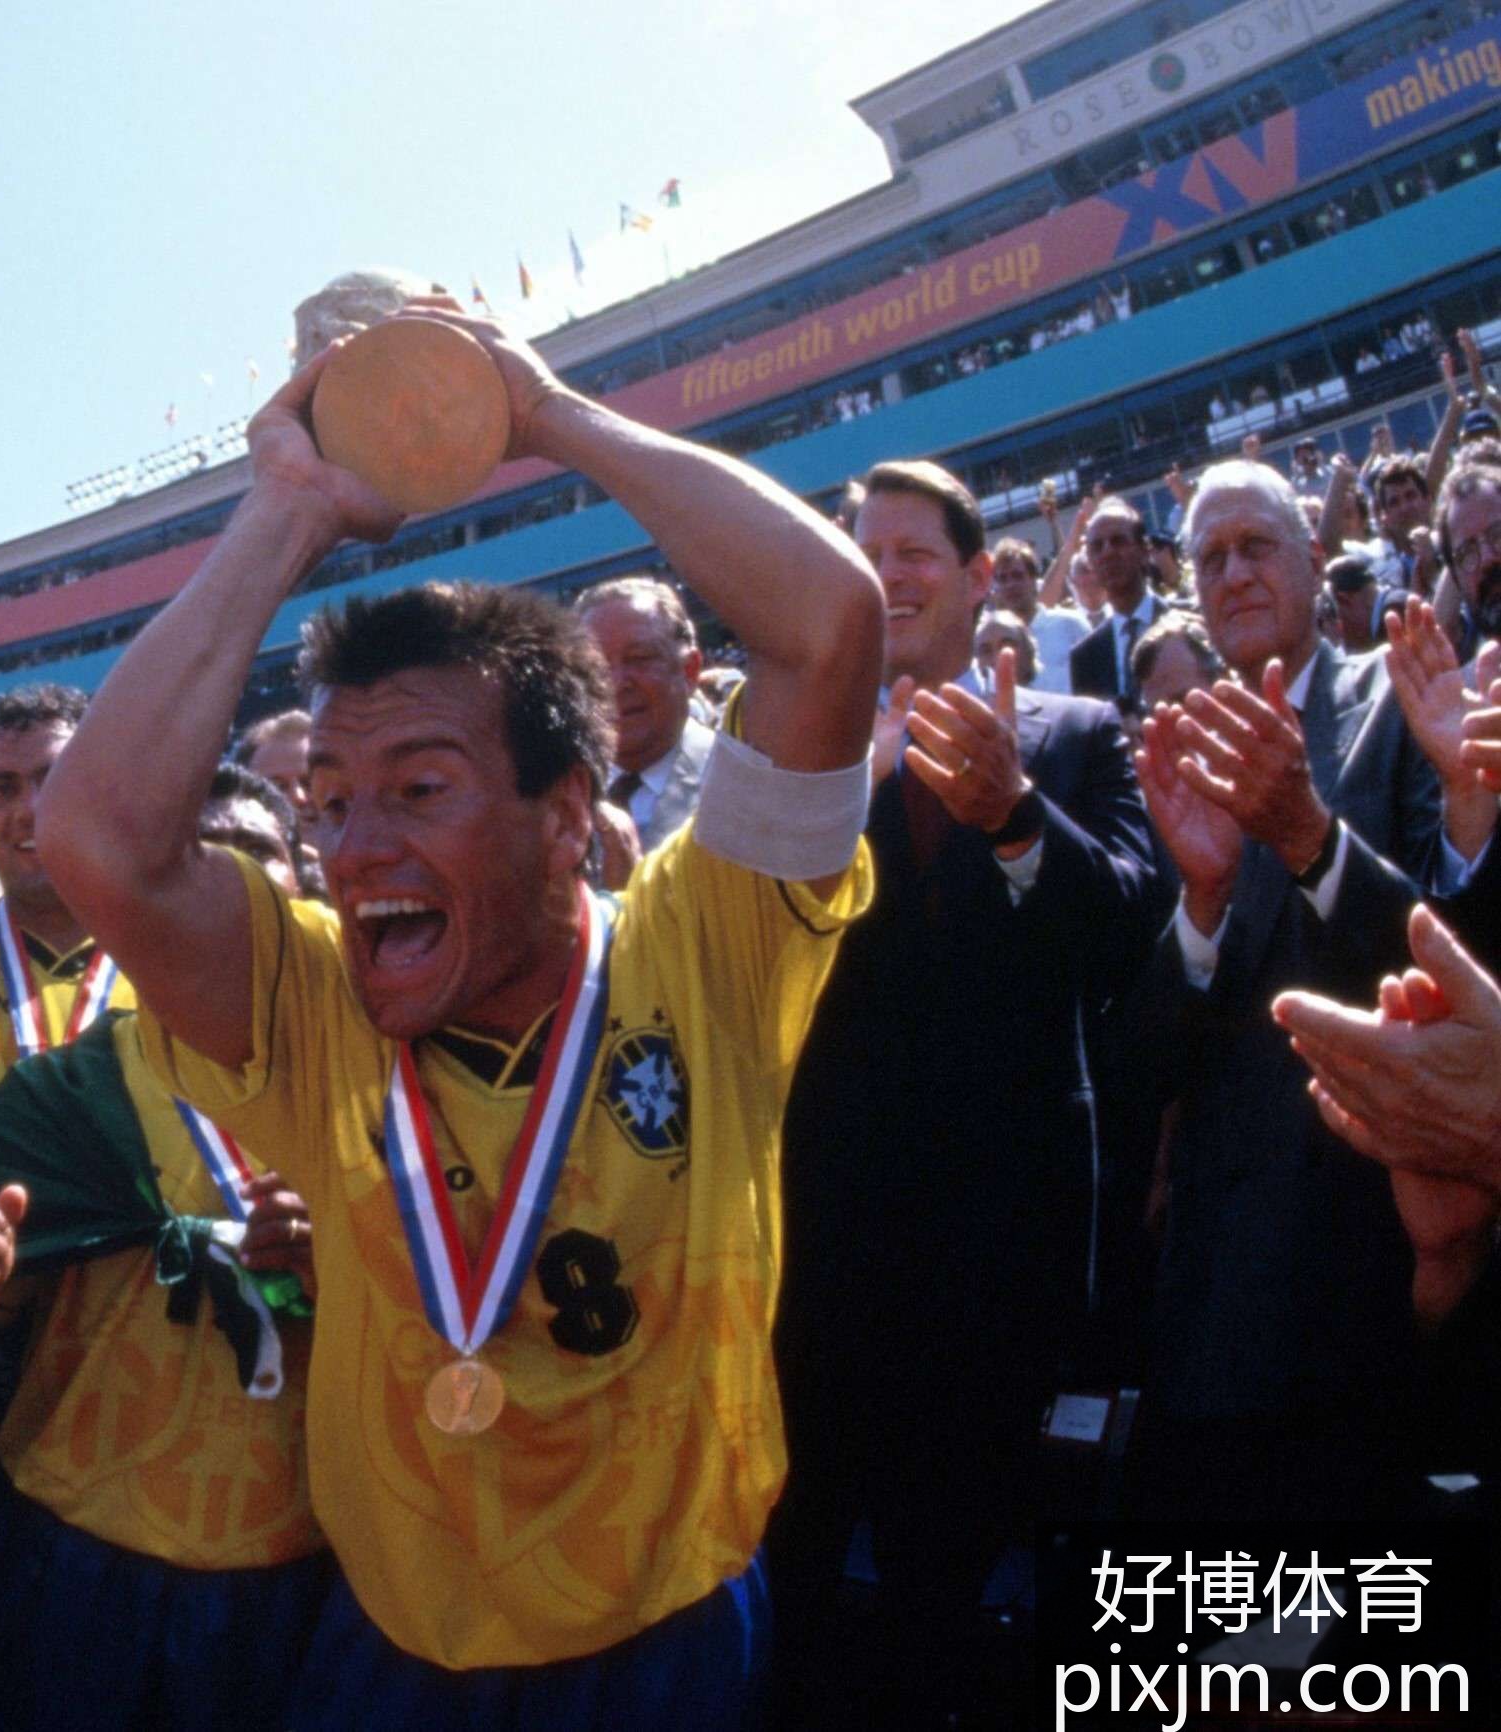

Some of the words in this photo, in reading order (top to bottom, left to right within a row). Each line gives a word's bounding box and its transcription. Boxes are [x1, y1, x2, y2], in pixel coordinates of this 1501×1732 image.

[1010, 79, 1141, 156] ROSE
[1366, 39, 1501, 128] making
[1102, 108, 1298, 260] XV
[682, 320, 832, 408] fifteenth
[845, 262, 957, 345] world
[969, 242, 1042, 297] cup
[536, 1227, 641, 1357] 8
